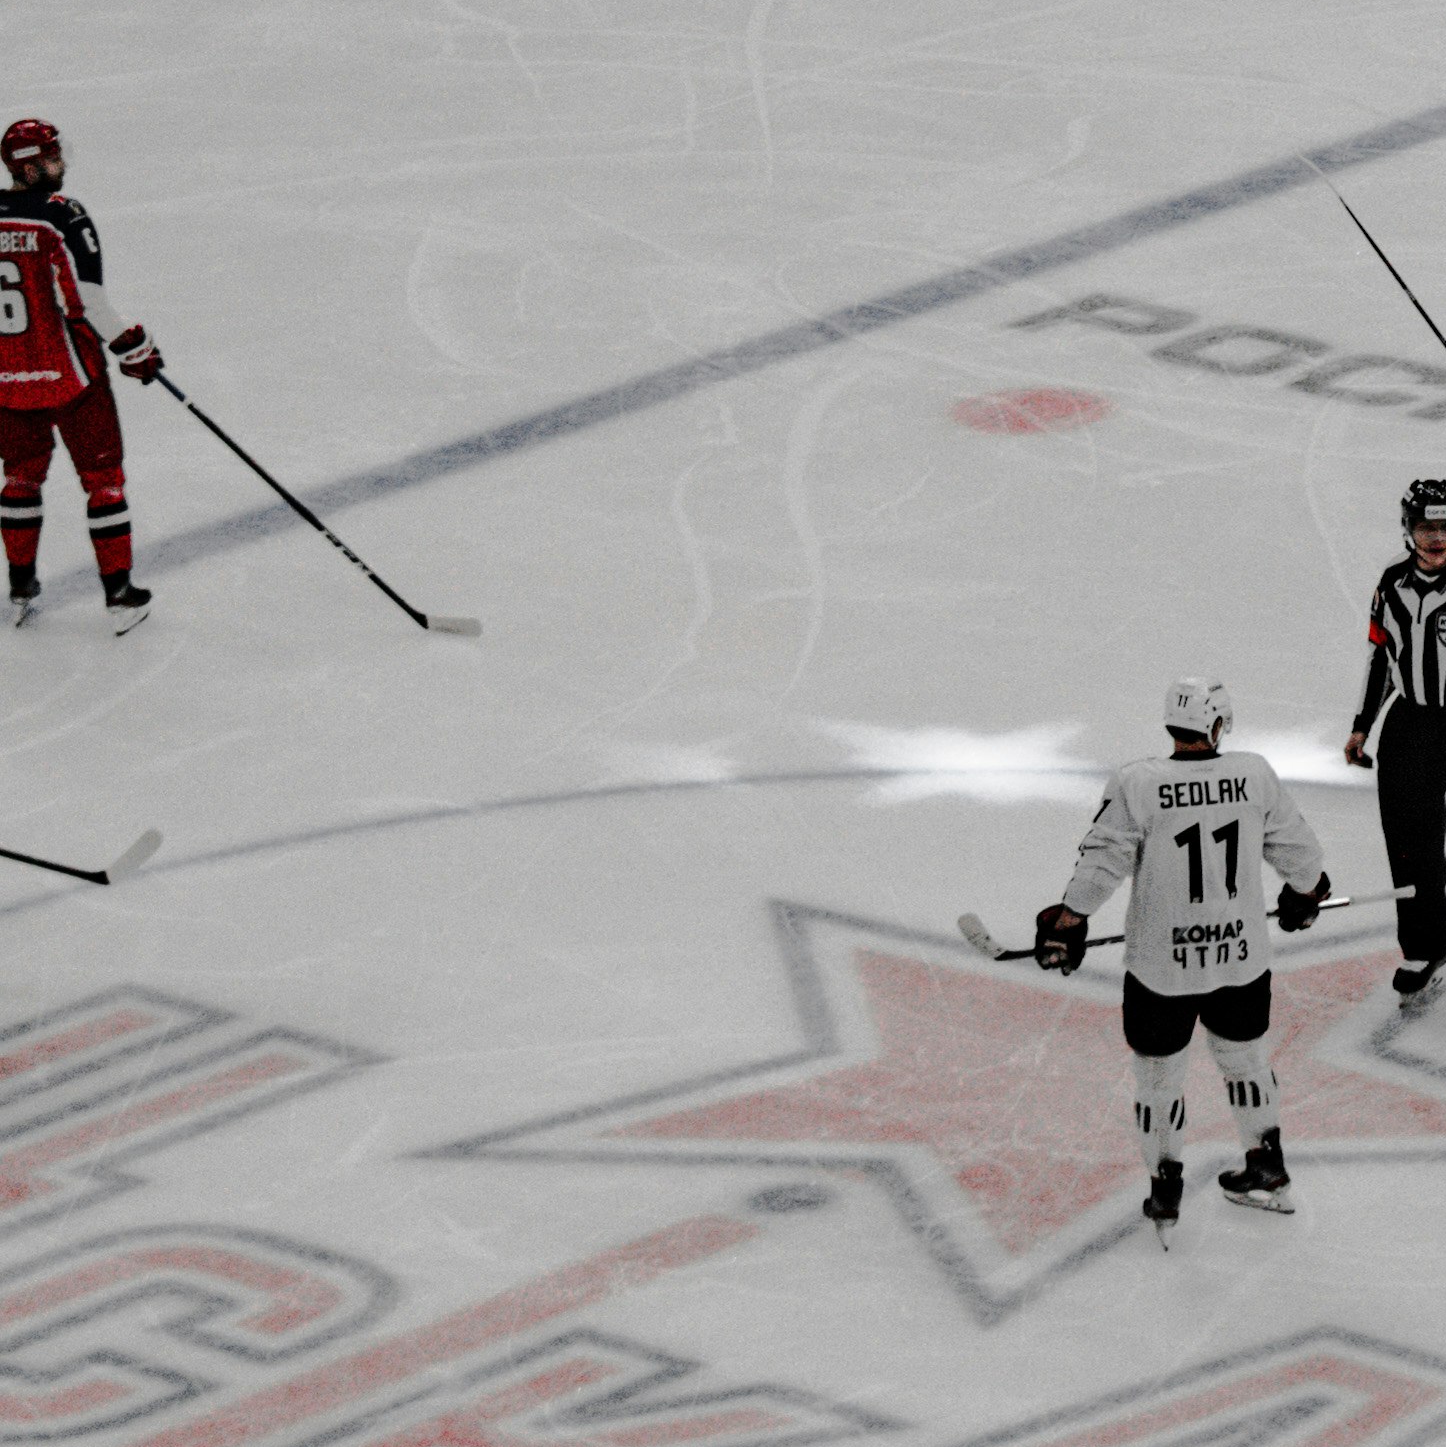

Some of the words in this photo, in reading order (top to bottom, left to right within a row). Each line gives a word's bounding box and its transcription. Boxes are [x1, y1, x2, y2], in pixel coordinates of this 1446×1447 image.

[1158, 777, 1249, 810] SEDLAK
[1174, 818, 1240, 904] 11
[1173, 919, 1244, 946] КОНАР
